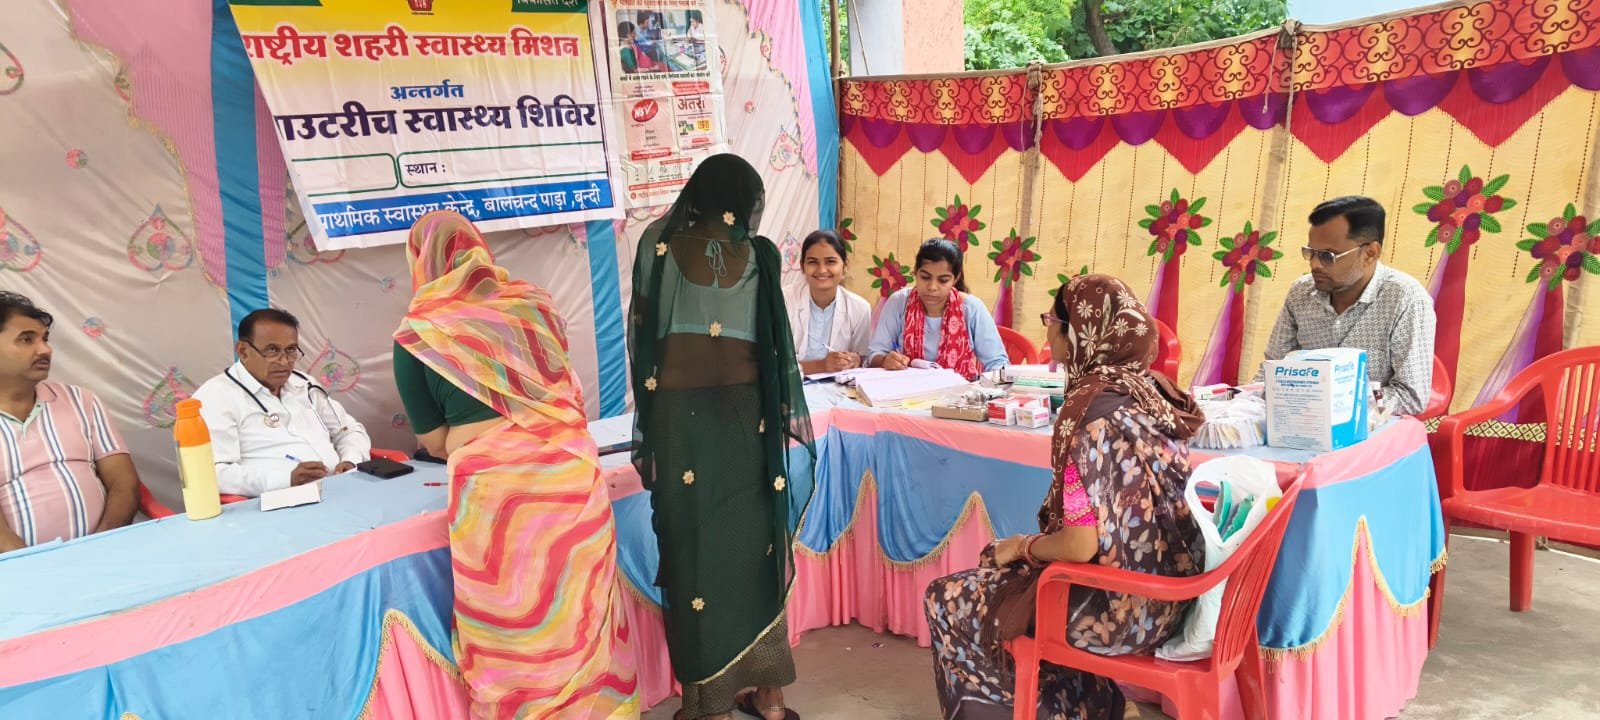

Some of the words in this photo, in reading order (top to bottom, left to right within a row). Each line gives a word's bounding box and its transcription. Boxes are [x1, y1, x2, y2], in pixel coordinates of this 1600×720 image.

[334, 26, 409, 61] शहरी
[413, 35, 506, 56] स्वास्थ्य
[511, 27, 579, 57] मिशन
[391, 79, 464, 101] अन्तर्गत
[273, 101, 398, 141] उटरीच
[403, 104, 512, 133] स्वास्थ्य
[516, 94, 597, 128] शिविर
[404, 162, 438, 176] स्थान
[1275, 366, 1319, 377] Prisafe
